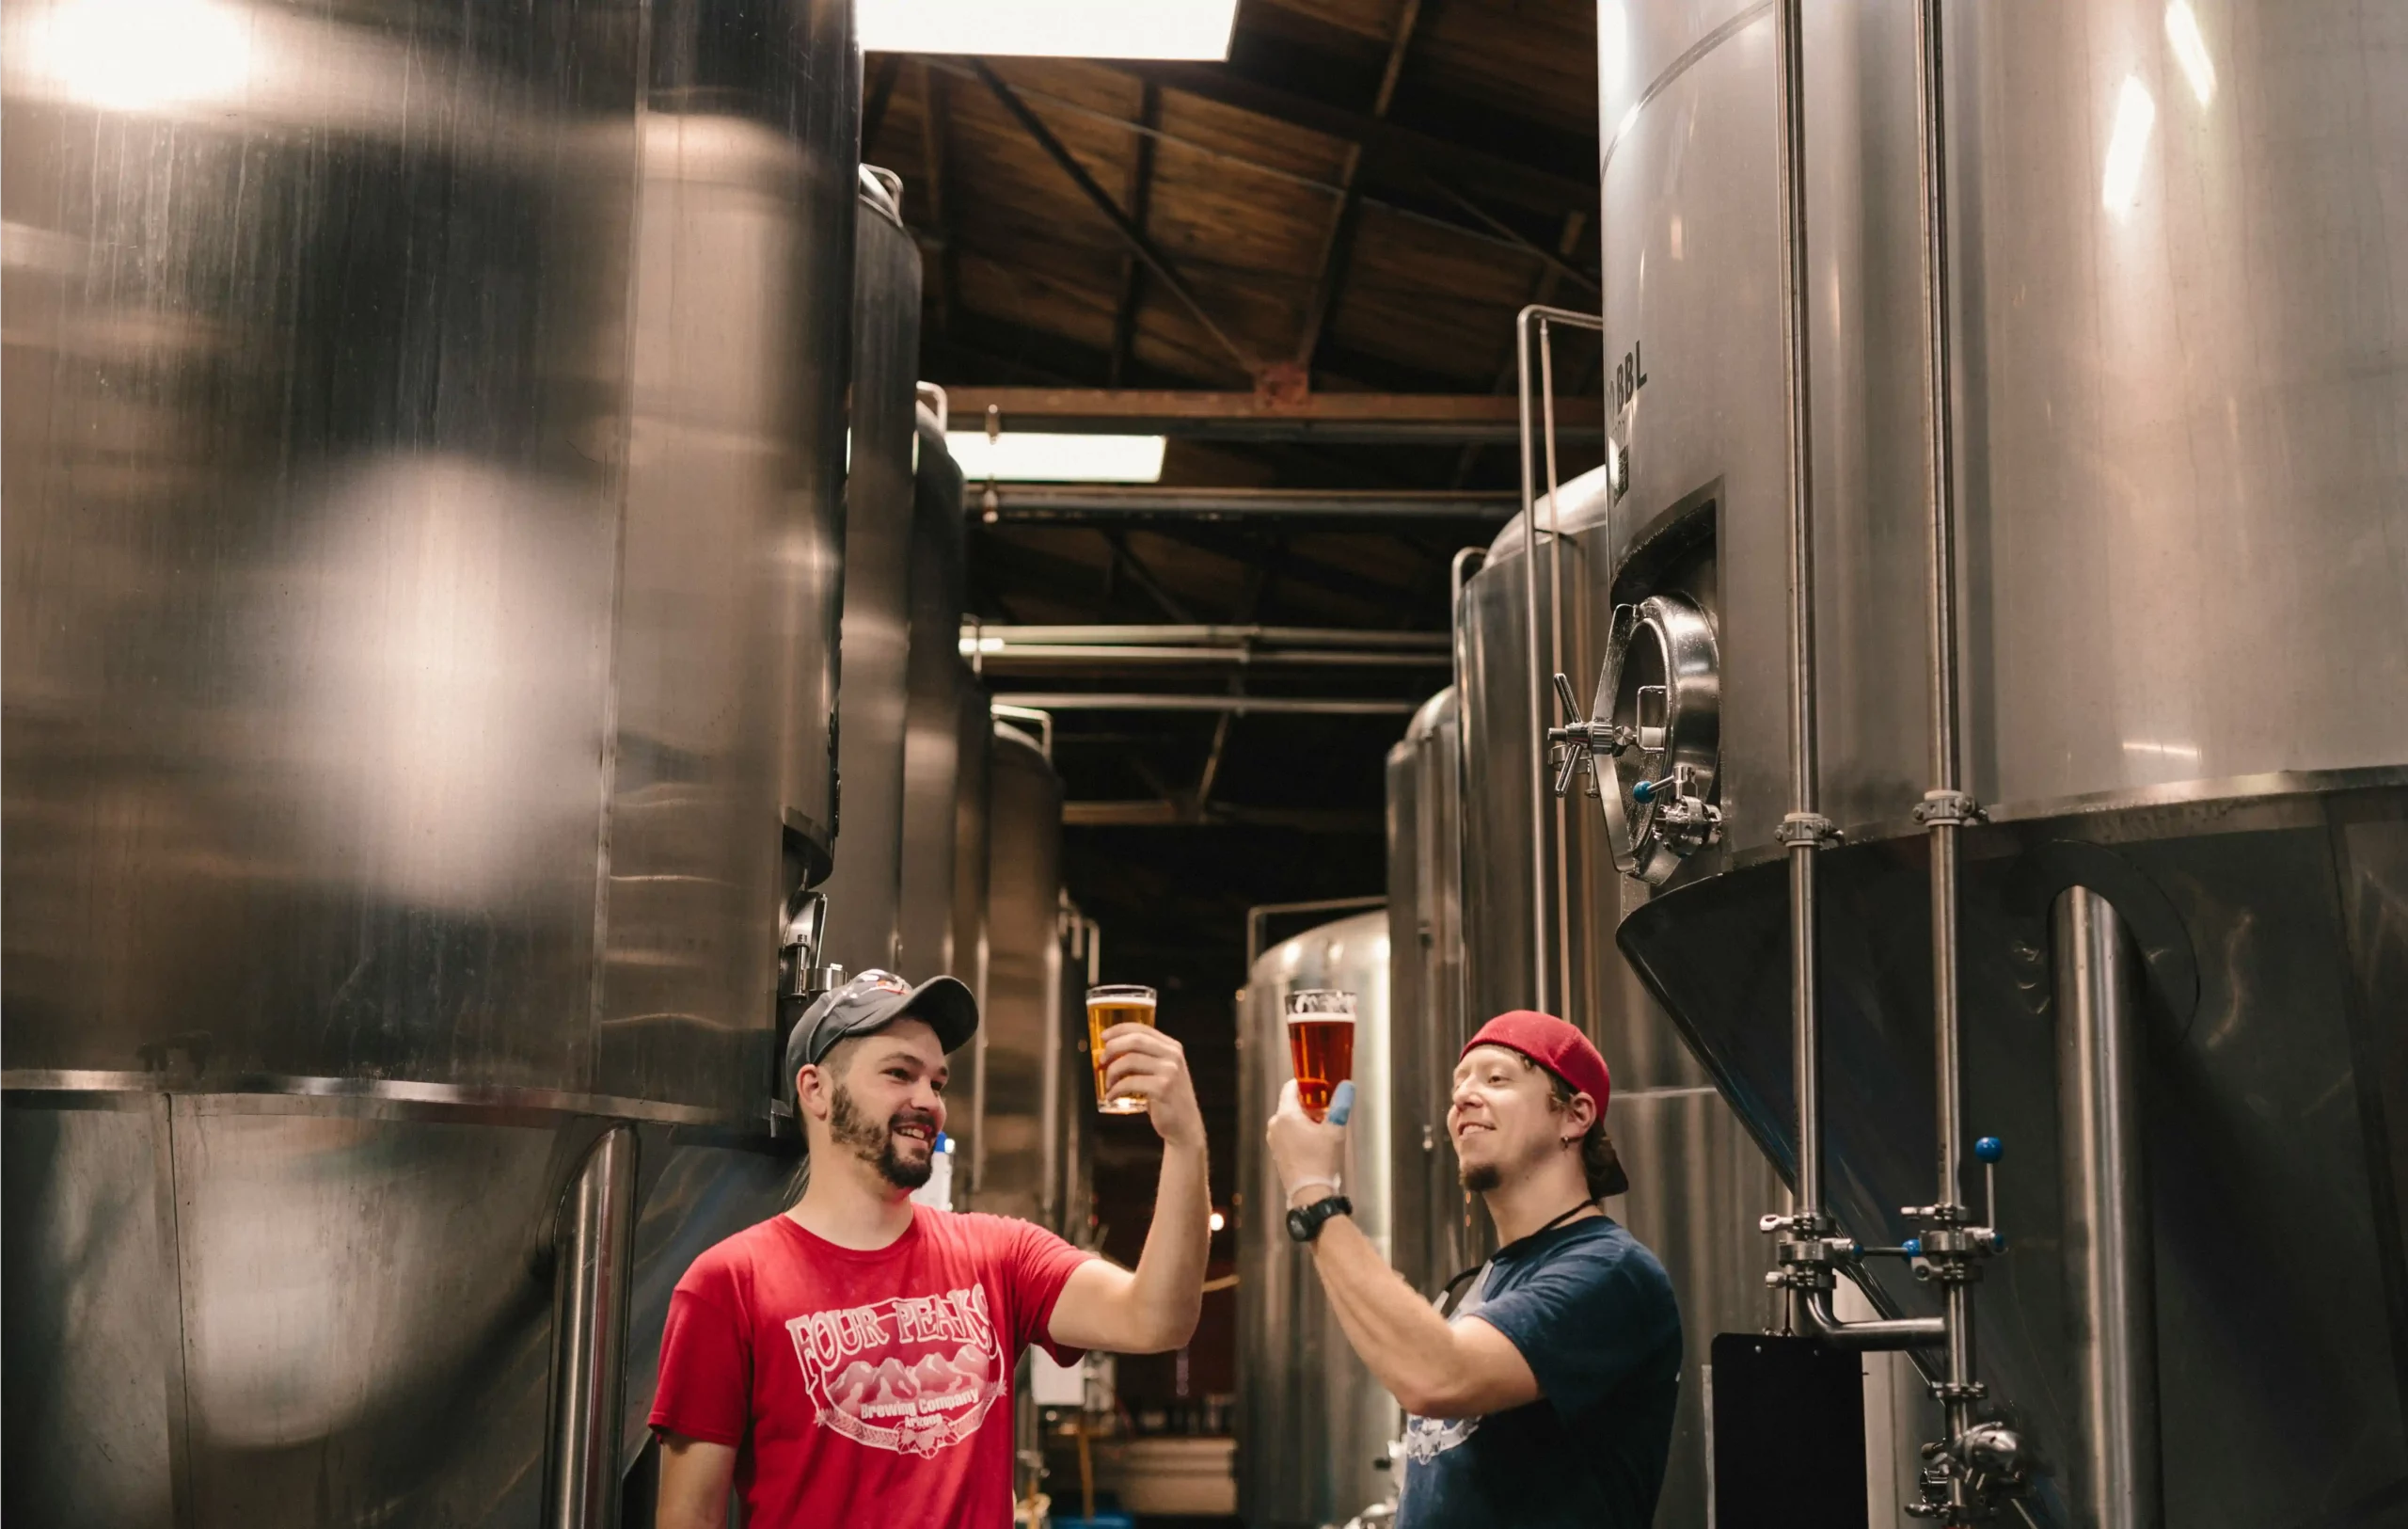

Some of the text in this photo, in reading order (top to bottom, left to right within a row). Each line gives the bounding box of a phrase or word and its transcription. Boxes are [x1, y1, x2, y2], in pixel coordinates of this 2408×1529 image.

[1616, 340, 1647, 416] BBL
[785, 1283, 1000, 1394] FOUR PEAKS
[861, 1387, 979, 1420] Brewing Company
[904, 1412, 943, 1428] Arizona
